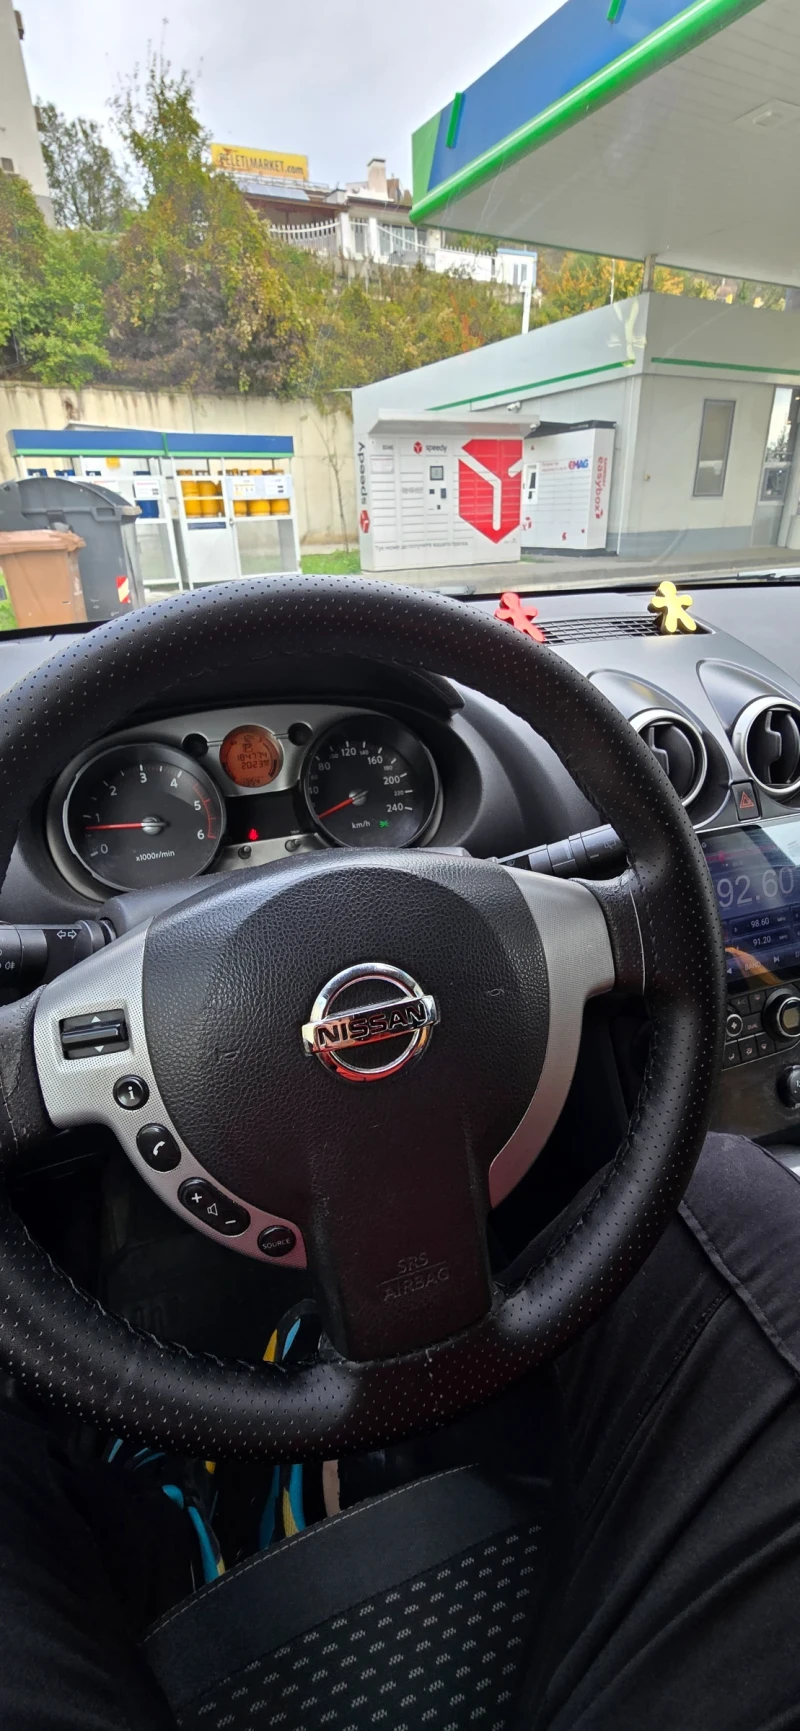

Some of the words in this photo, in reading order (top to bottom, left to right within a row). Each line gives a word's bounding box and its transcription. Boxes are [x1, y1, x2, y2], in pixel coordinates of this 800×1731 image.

[425, 445, 447, 453] speedy
[358, 441, 368, 505] speedy
[595, 457, 604, 512] easybox
[341, 748, 357, 757] 120
[367, 756, 381, 765] 160
[318, 762, 331, 771] 80
[140, 772, 148, 783] 3
[383, 777, 401, 785] 200
[171, 778, 180, 788] 4
[110, 786, 118, 796] 2
[195, 801, 202, 811] 5
[386, 803, 404, 813] 240
[96, 813, 100, 823] 1
[352, 820, 371, 829] km/h
[197, 829, 205, 840] 6
[101, 844, 109, 854] 0
[716, 866, 795, 908] 92.60
[750, 917, 770, 928] 98.60
[752, 935, 772, 947] 91.20
[744, 962, 762, 971] BAND
[317, 1001, 427, 1046] NISSAN
[262, 1237, 291, 1250] SOURCE
[397, 1251, 428, 1274] SRS
[383, 1267, 449, 1302] AIRBAG
